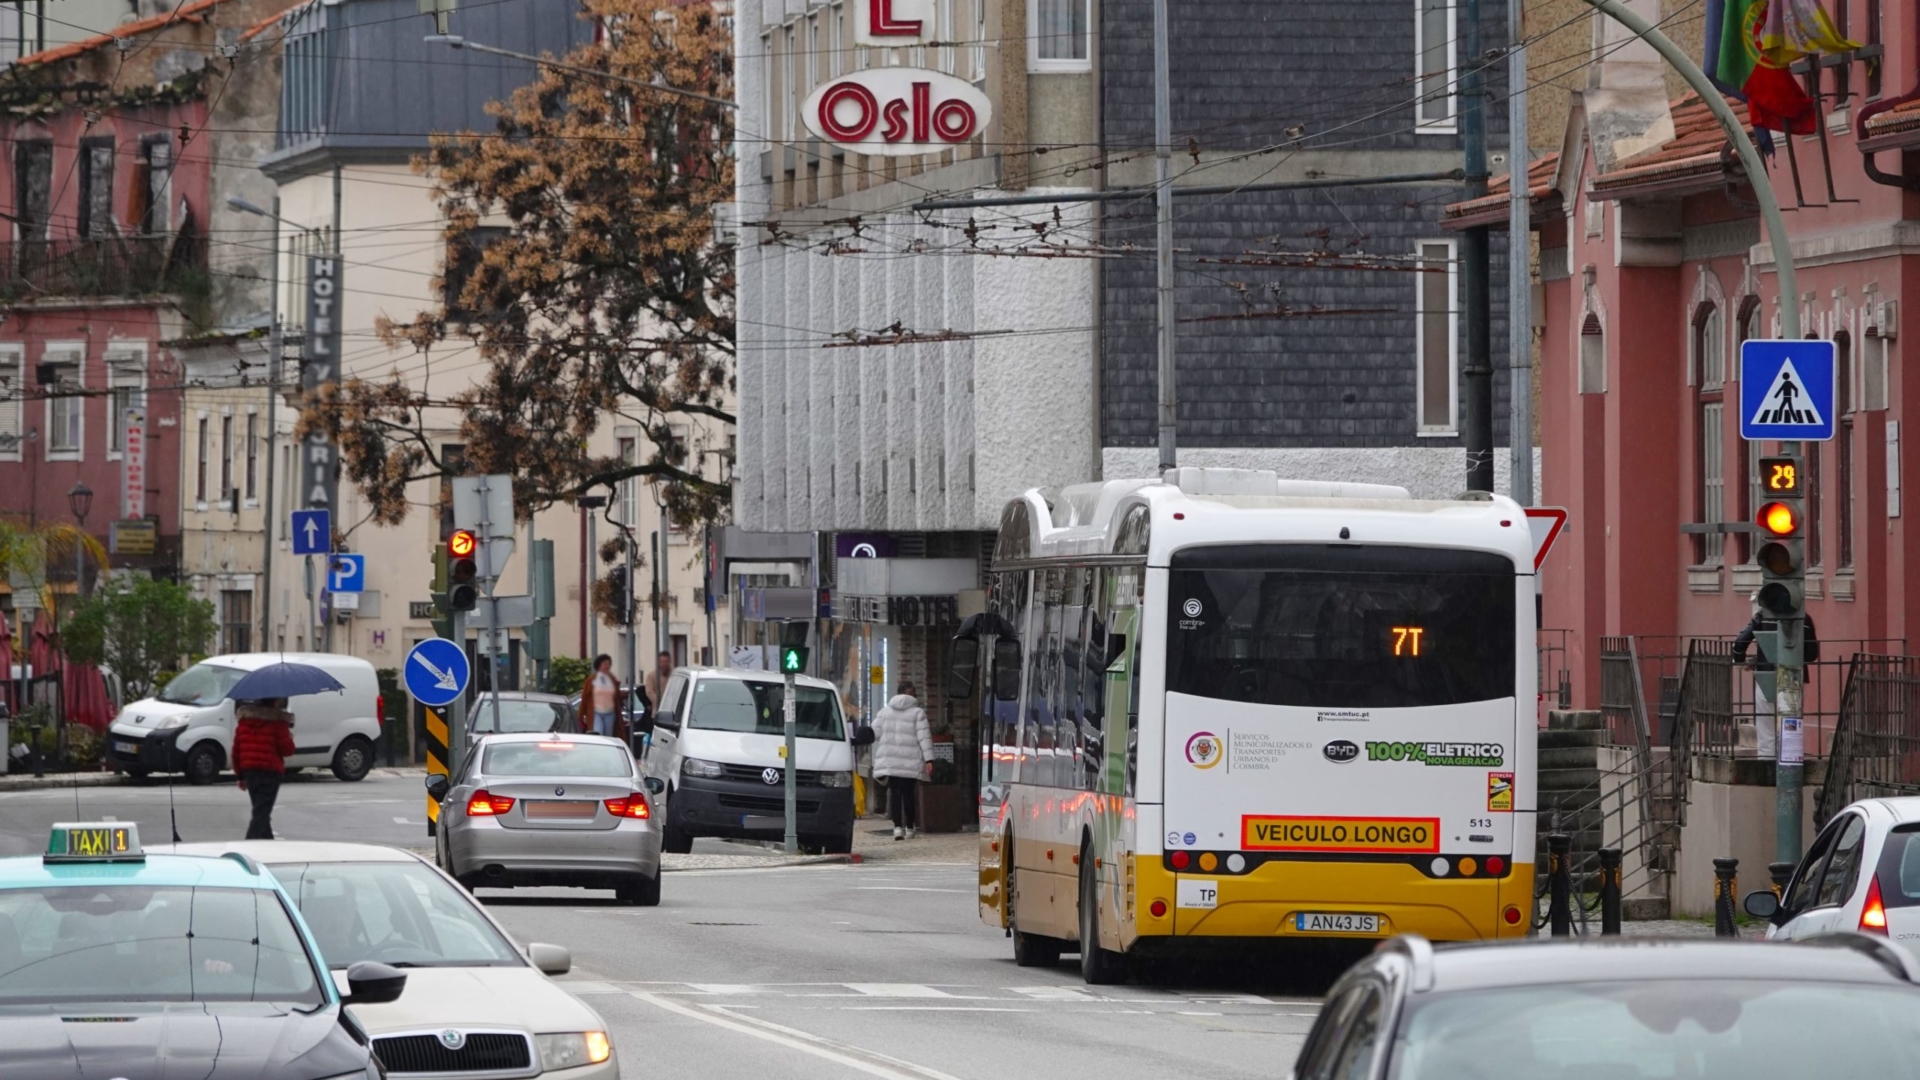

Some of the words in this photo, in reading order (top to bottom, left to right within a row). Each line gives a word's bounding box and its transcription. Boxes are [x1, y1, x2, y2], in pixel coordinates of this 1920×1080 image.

[818, 81, 976, 143] Oslo
[314, 259, 333, 354] HOTEL
[1771, 465, 1794, 488] 29
[335, 557, 357, 589] P
[887, 596, 962, 626] HOTEL
[373, 630, 385, 645] H
[1392, 628, 1423, 656] 7T
[1233, 741, 1305, 749] MUNICIPALIZADOS
[1327, 745, 1355, 756] BYD
[1365, 741, 1428, 761] 100%
[1233, 755, 1270, 763] URBANOS
[1470, 819, 1492, 828] 513
[71, 829, 110, 852] TAXI
[116, 829, 126, 850] 1
[1256, 824, 1347, 843] VEICULO
[1354, 825, 1428, 844] LONGO
[1200, 889, 1217, 901] TP
